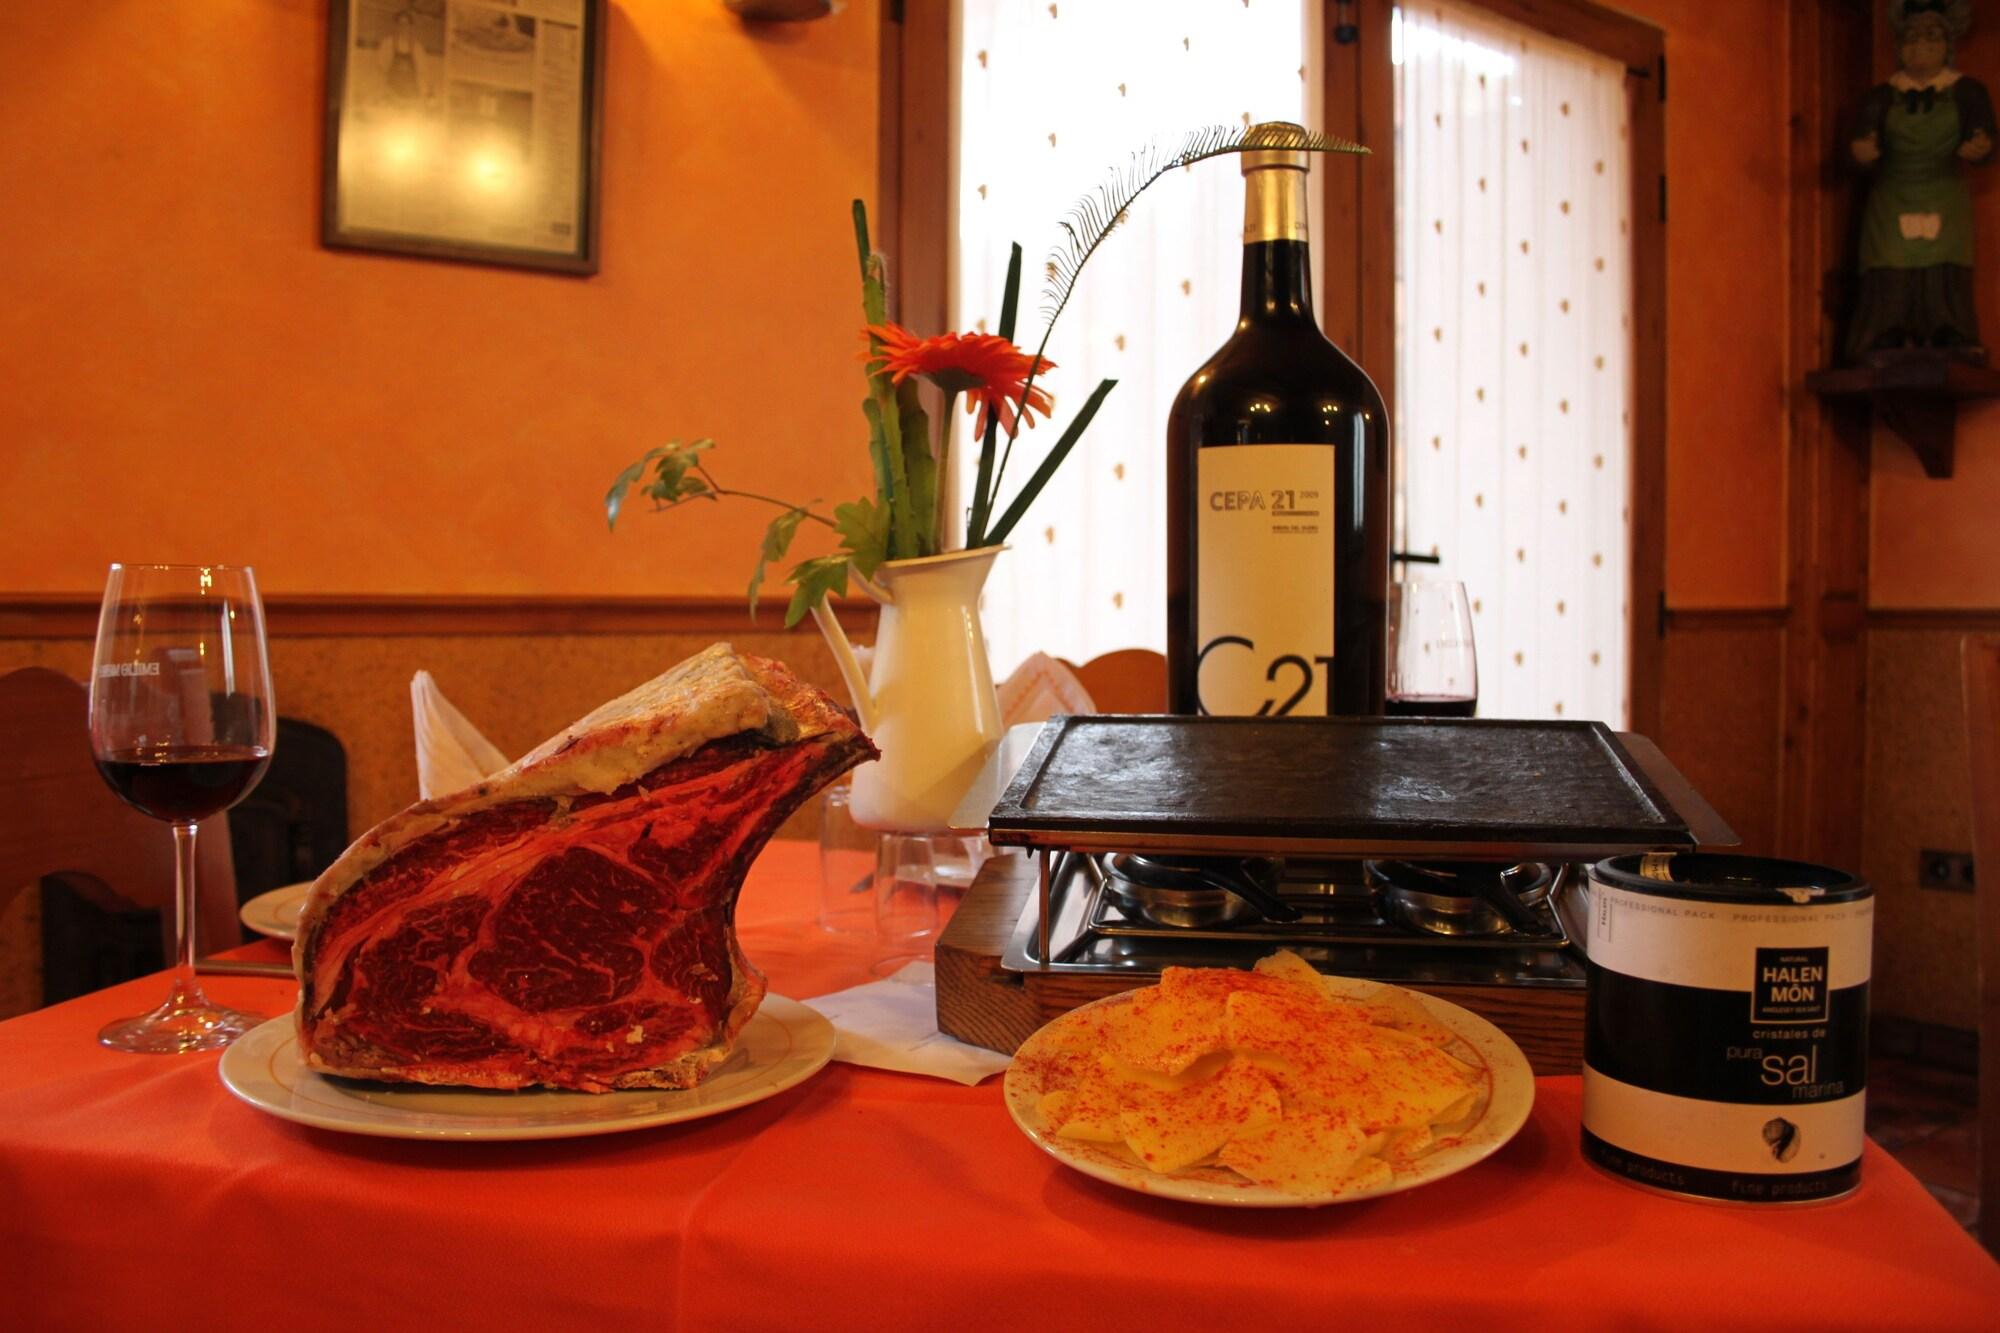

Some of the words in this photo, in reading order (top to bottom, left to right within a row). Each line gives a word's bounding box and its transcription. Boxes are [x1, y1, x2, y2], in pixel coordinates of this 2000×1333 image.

[1209, 489, 1266, 511] CEPA
[1271, 489, 1296, 510] 21
[1685, 909, 1715, 920] PACK
[1732, 912, 1818, 923] PROFESSIONAL
[1763, 965, 1823, 983] HALEN
[1771, 984, 1815, 1003] MÔN
[1752, 1028, 1809, 1040] cristales
[1811, 1027, 1827, 1038] de
[1727, 1046, 1763, 1060] pura
[1760, 1044, 1818, 1086] sal
[1792, 1079, 1845, 1099] marina
